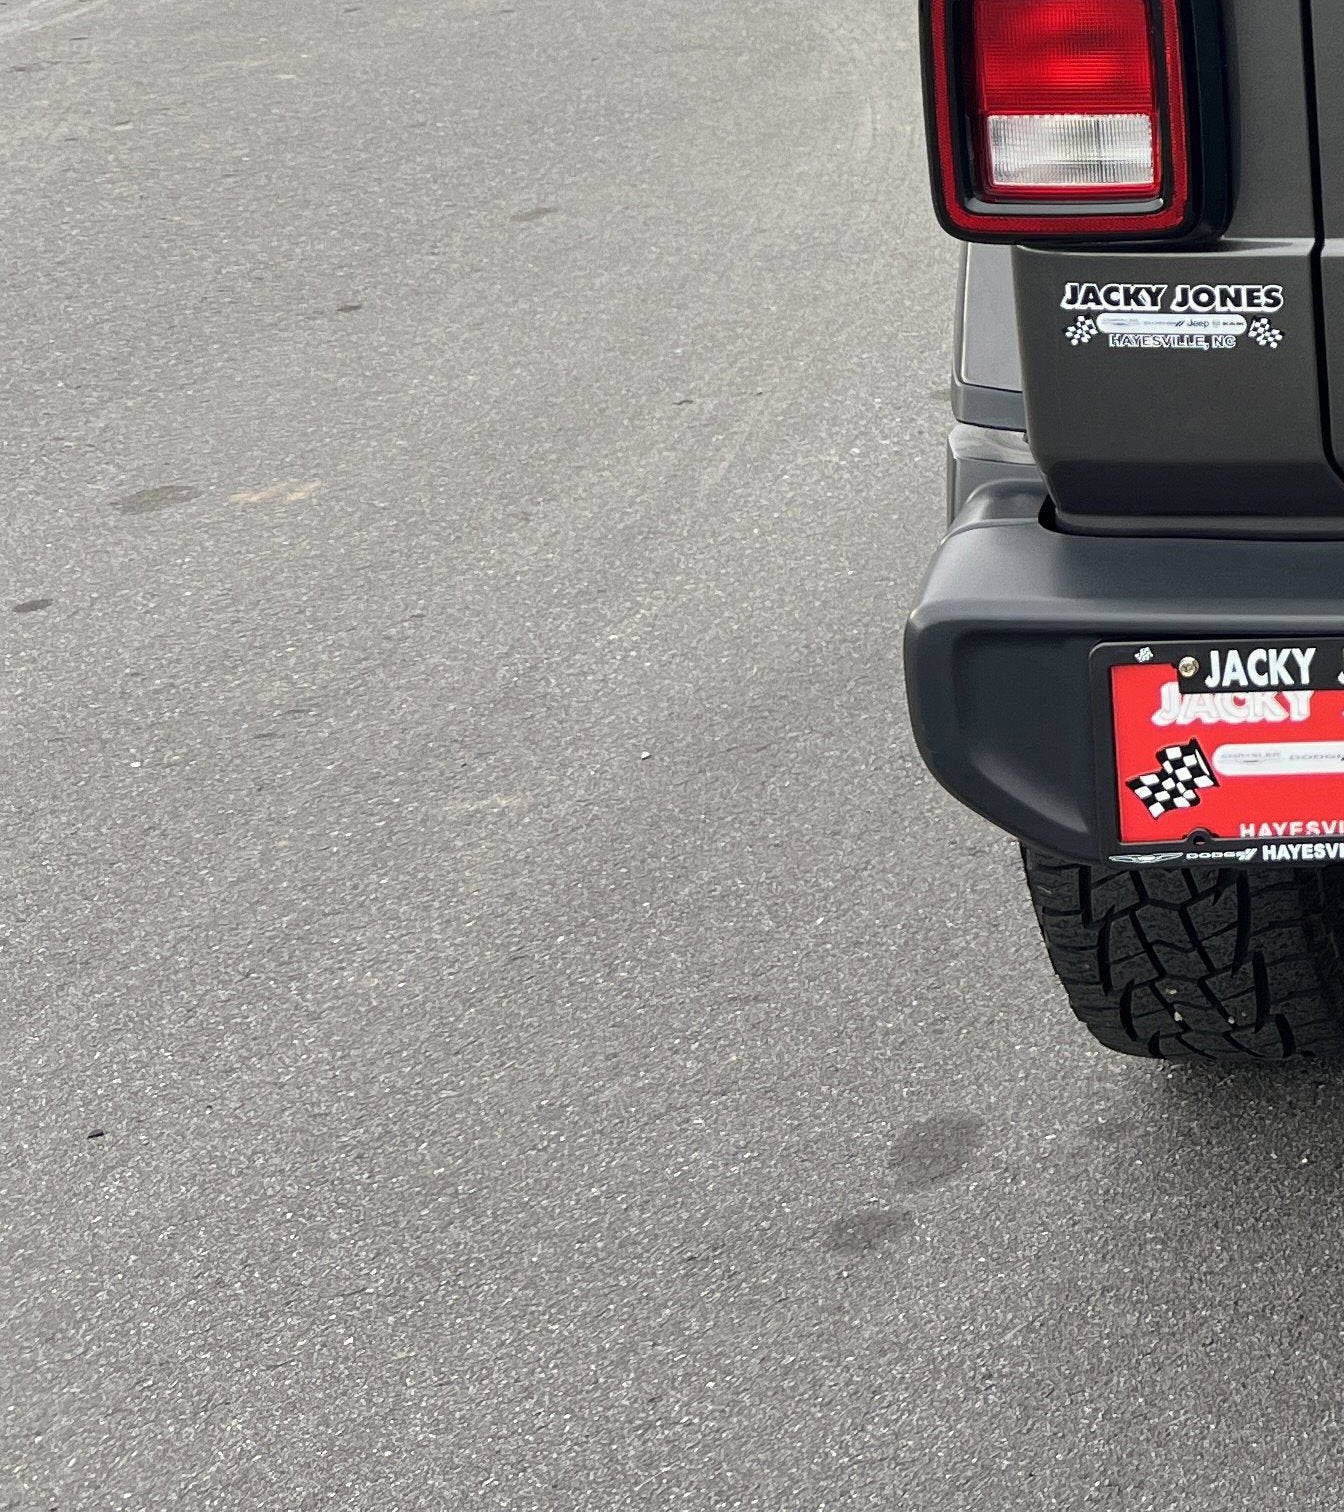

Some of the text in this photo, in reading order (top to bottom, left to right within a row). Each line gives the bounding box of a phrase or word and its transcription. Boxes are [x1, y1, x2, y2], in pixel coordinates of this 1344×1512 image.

[1060, 282, 1284, 312] JACKY JONES
[1108, 334, 1236, 350] HAYESVILLE, NC
[1204, 647, 1317, 688] JACKY
